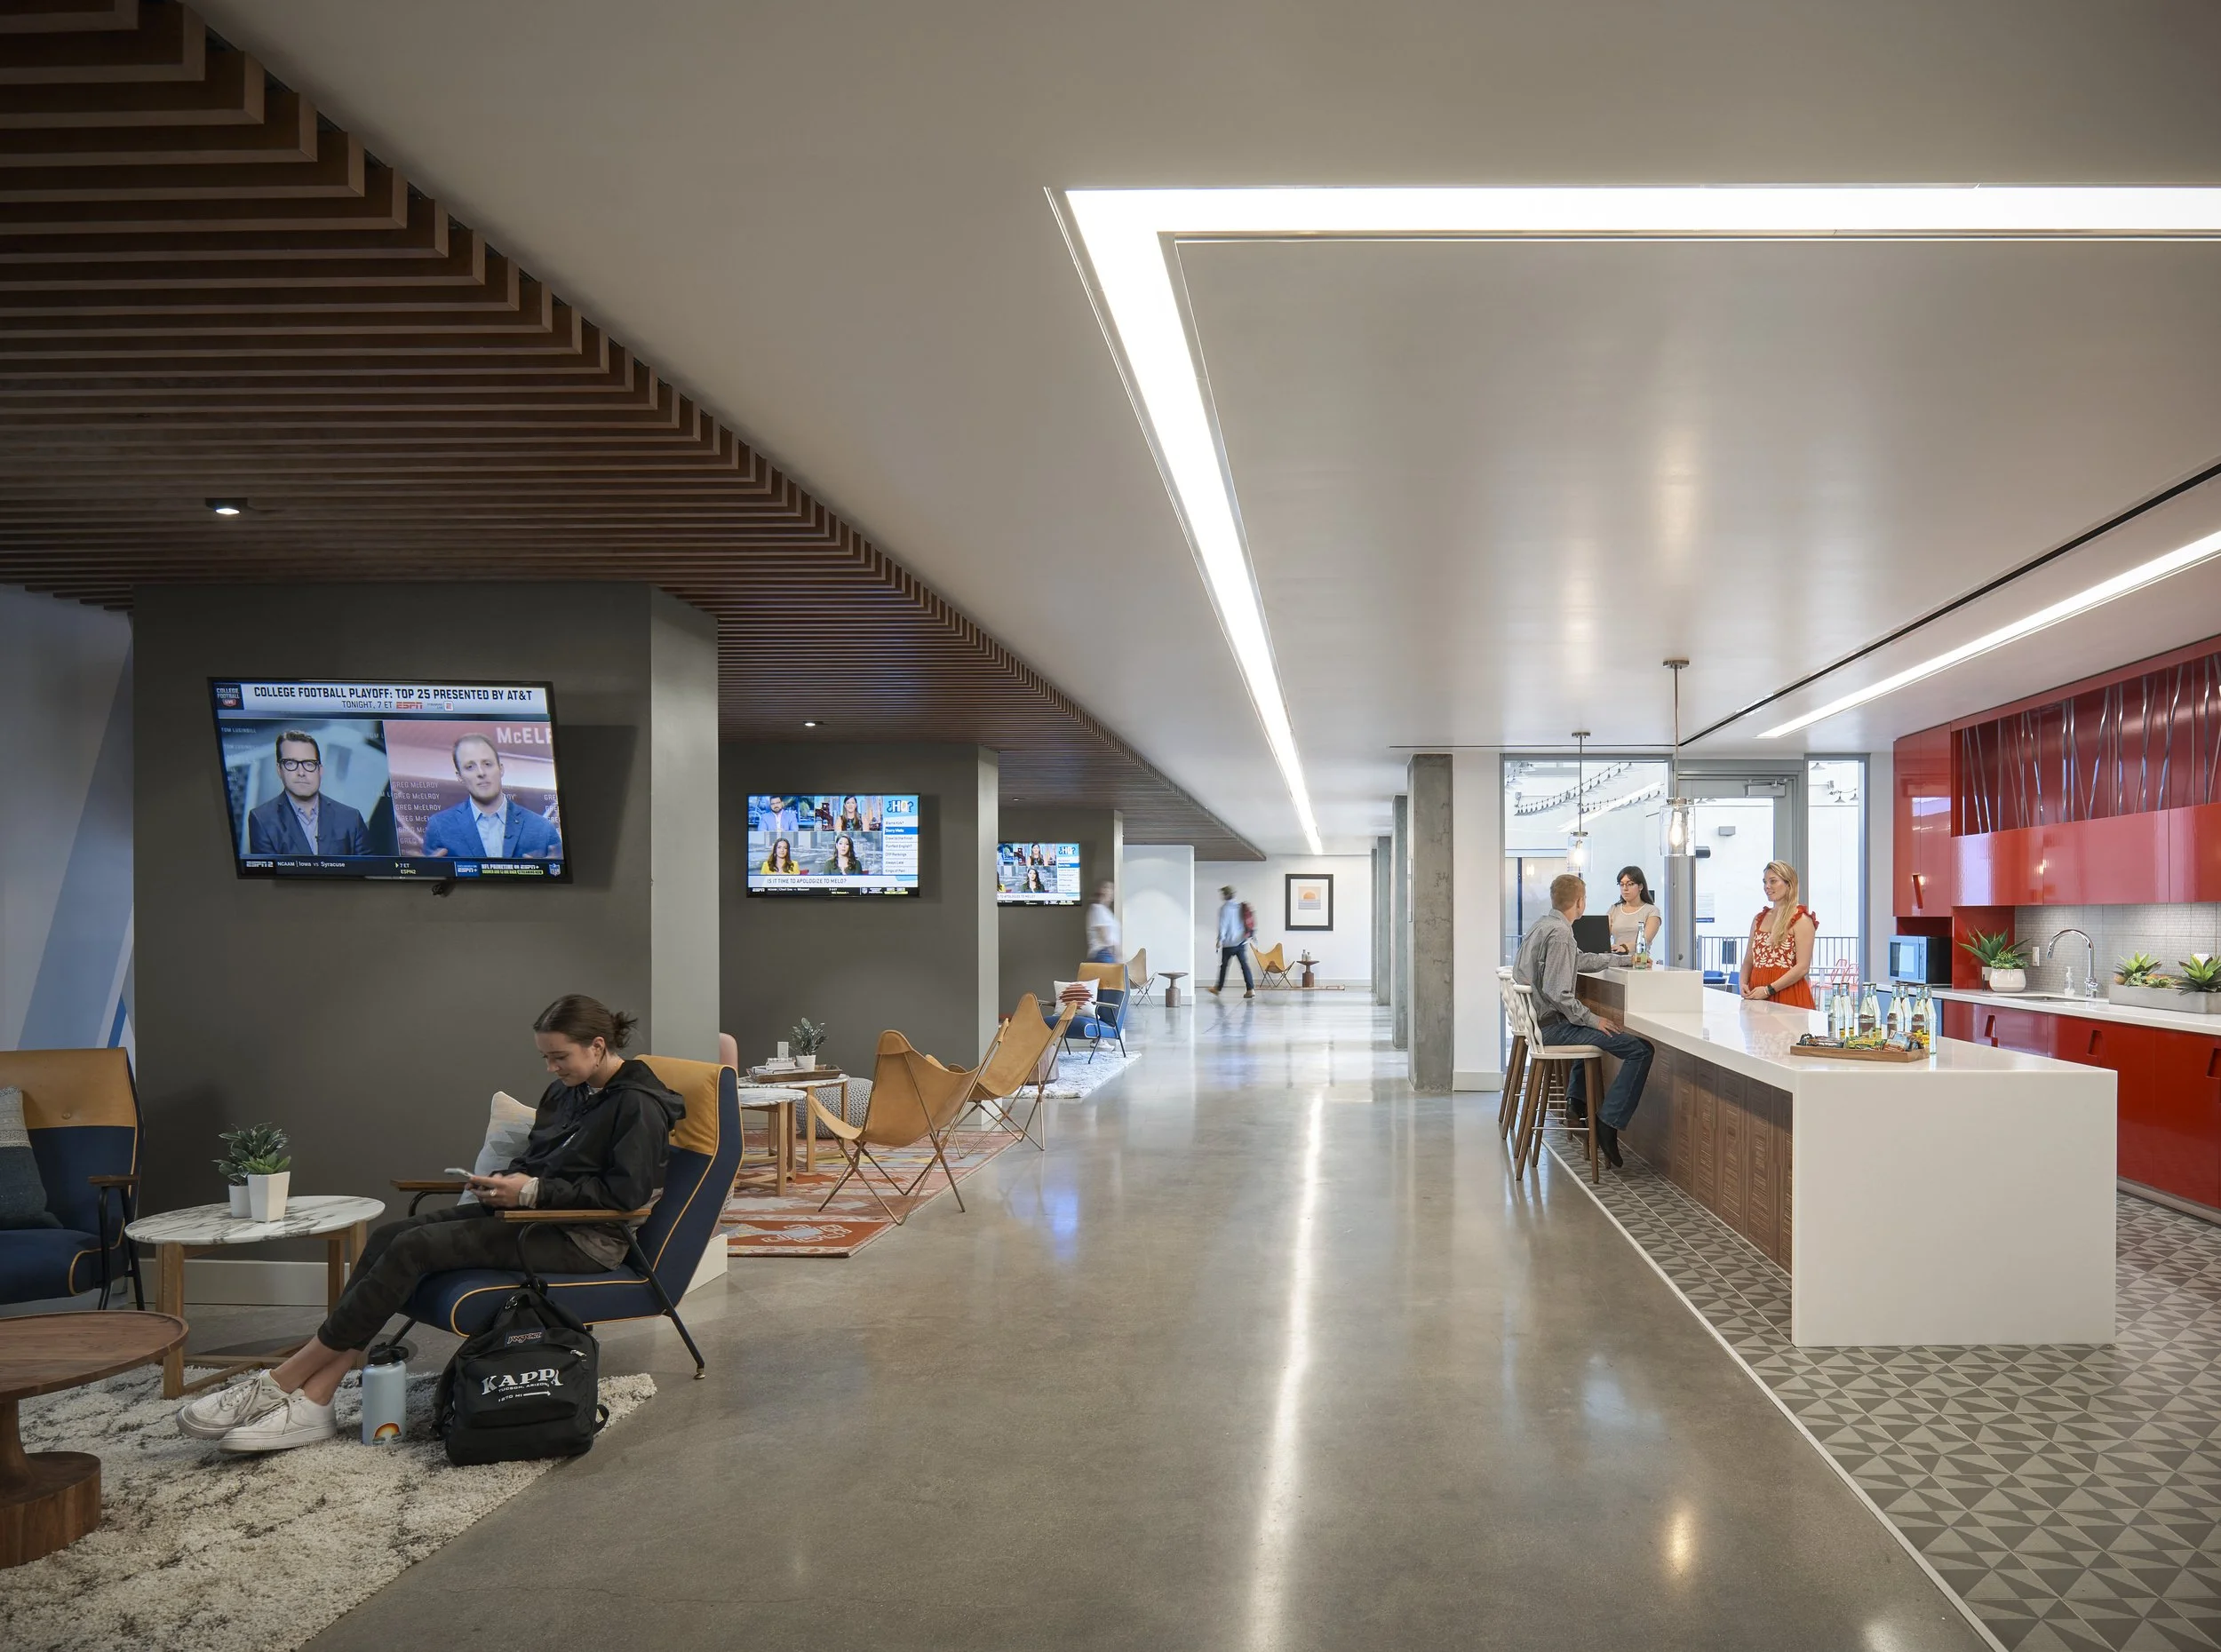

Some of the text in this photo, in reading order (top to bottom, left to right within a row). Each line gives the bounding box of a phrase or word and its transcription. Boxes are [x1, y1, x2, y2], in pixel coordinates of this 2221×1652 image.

[254, 687, 532, 701] COLLEGE FOOTBALL PLAYOFF: TOP 25 PRESENTED BY AT&T
[507, 1332, 542, 1344] JANSPORT
[482, 1368, 564, 1395] KAPPA
